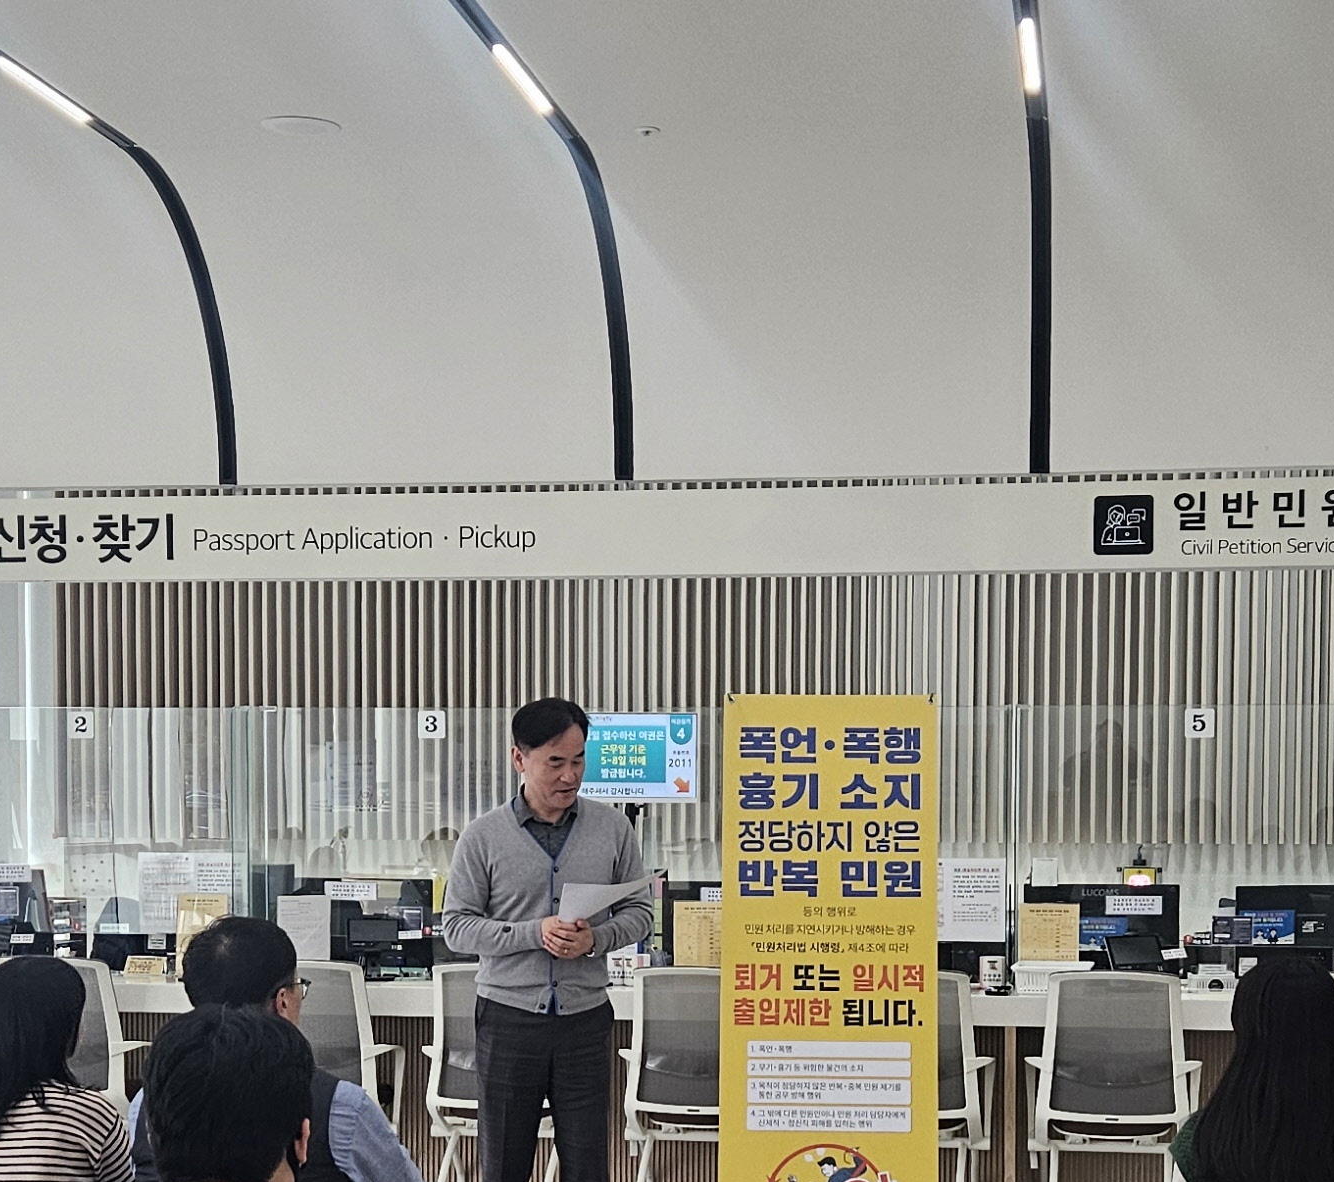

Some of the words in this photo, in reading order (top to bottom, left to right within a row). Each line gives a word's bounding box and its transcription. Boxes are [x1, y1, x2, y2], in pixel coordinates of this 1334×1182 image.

[193, 528, 296, 555] Passport
[302, 526, 433, 555] Application
[459, 524, 537, 552] Pickup
[1181, 538, 1214, 555] Civil
[1218, 538, 1282, 555] Petition
[73, 716, 88, 733] 2
[424, 716, 438, 733] 3
[1192, 714, 1207, 732] 5
[602, 730, 637, 741] 접수하신
[638, 730, 665, 741] 여권은
[676, 727, 686, 740] 4
[600, 744, 627, 755] 근무일
[629, 744, 647, 755] 기준
[739, 726, 922, 764] 폭언·폭행
[601, 756, 627, 766] 5~8일
[629, 756, 647, 766] 뒤에
[668, 759, 692, 768] 2011
[600, 768, 646, 779] 발급됩니다.
[738, 772, 819, 810] 흉기
[840, 773, 921, 810] 소지
[738, 820, 852, 853] 정당하지
[864, 820, 921, 853] 않은
[738, 860, 819, 897] 반복
[841, 860, 922, 898] 민원
[1081, 888, 1120, 897] LUCOMS
[803, 907, 823, 917] 등의
[826, 906, 857, 917] 행위로
[744, 924, 764, 935] 민원
[766, 923, 794, 935] 처리를
[796, 923, 854, 935] 지연시키거나
[855, 924, 894, 935] 방해하는
[896, 924, 916, 936] 경우
[847, 942, 886, 954] 제4조에
[889, 943, 909, 953] 따라
[734, 963, 782, 992] 퇴거
[793, 964, 840, 992] 또는
[852, 964, 925, 993] 일시적
[733, 998, 832, 1026] 출입제한
[842, 999, 923, 1027] 됩니다.
